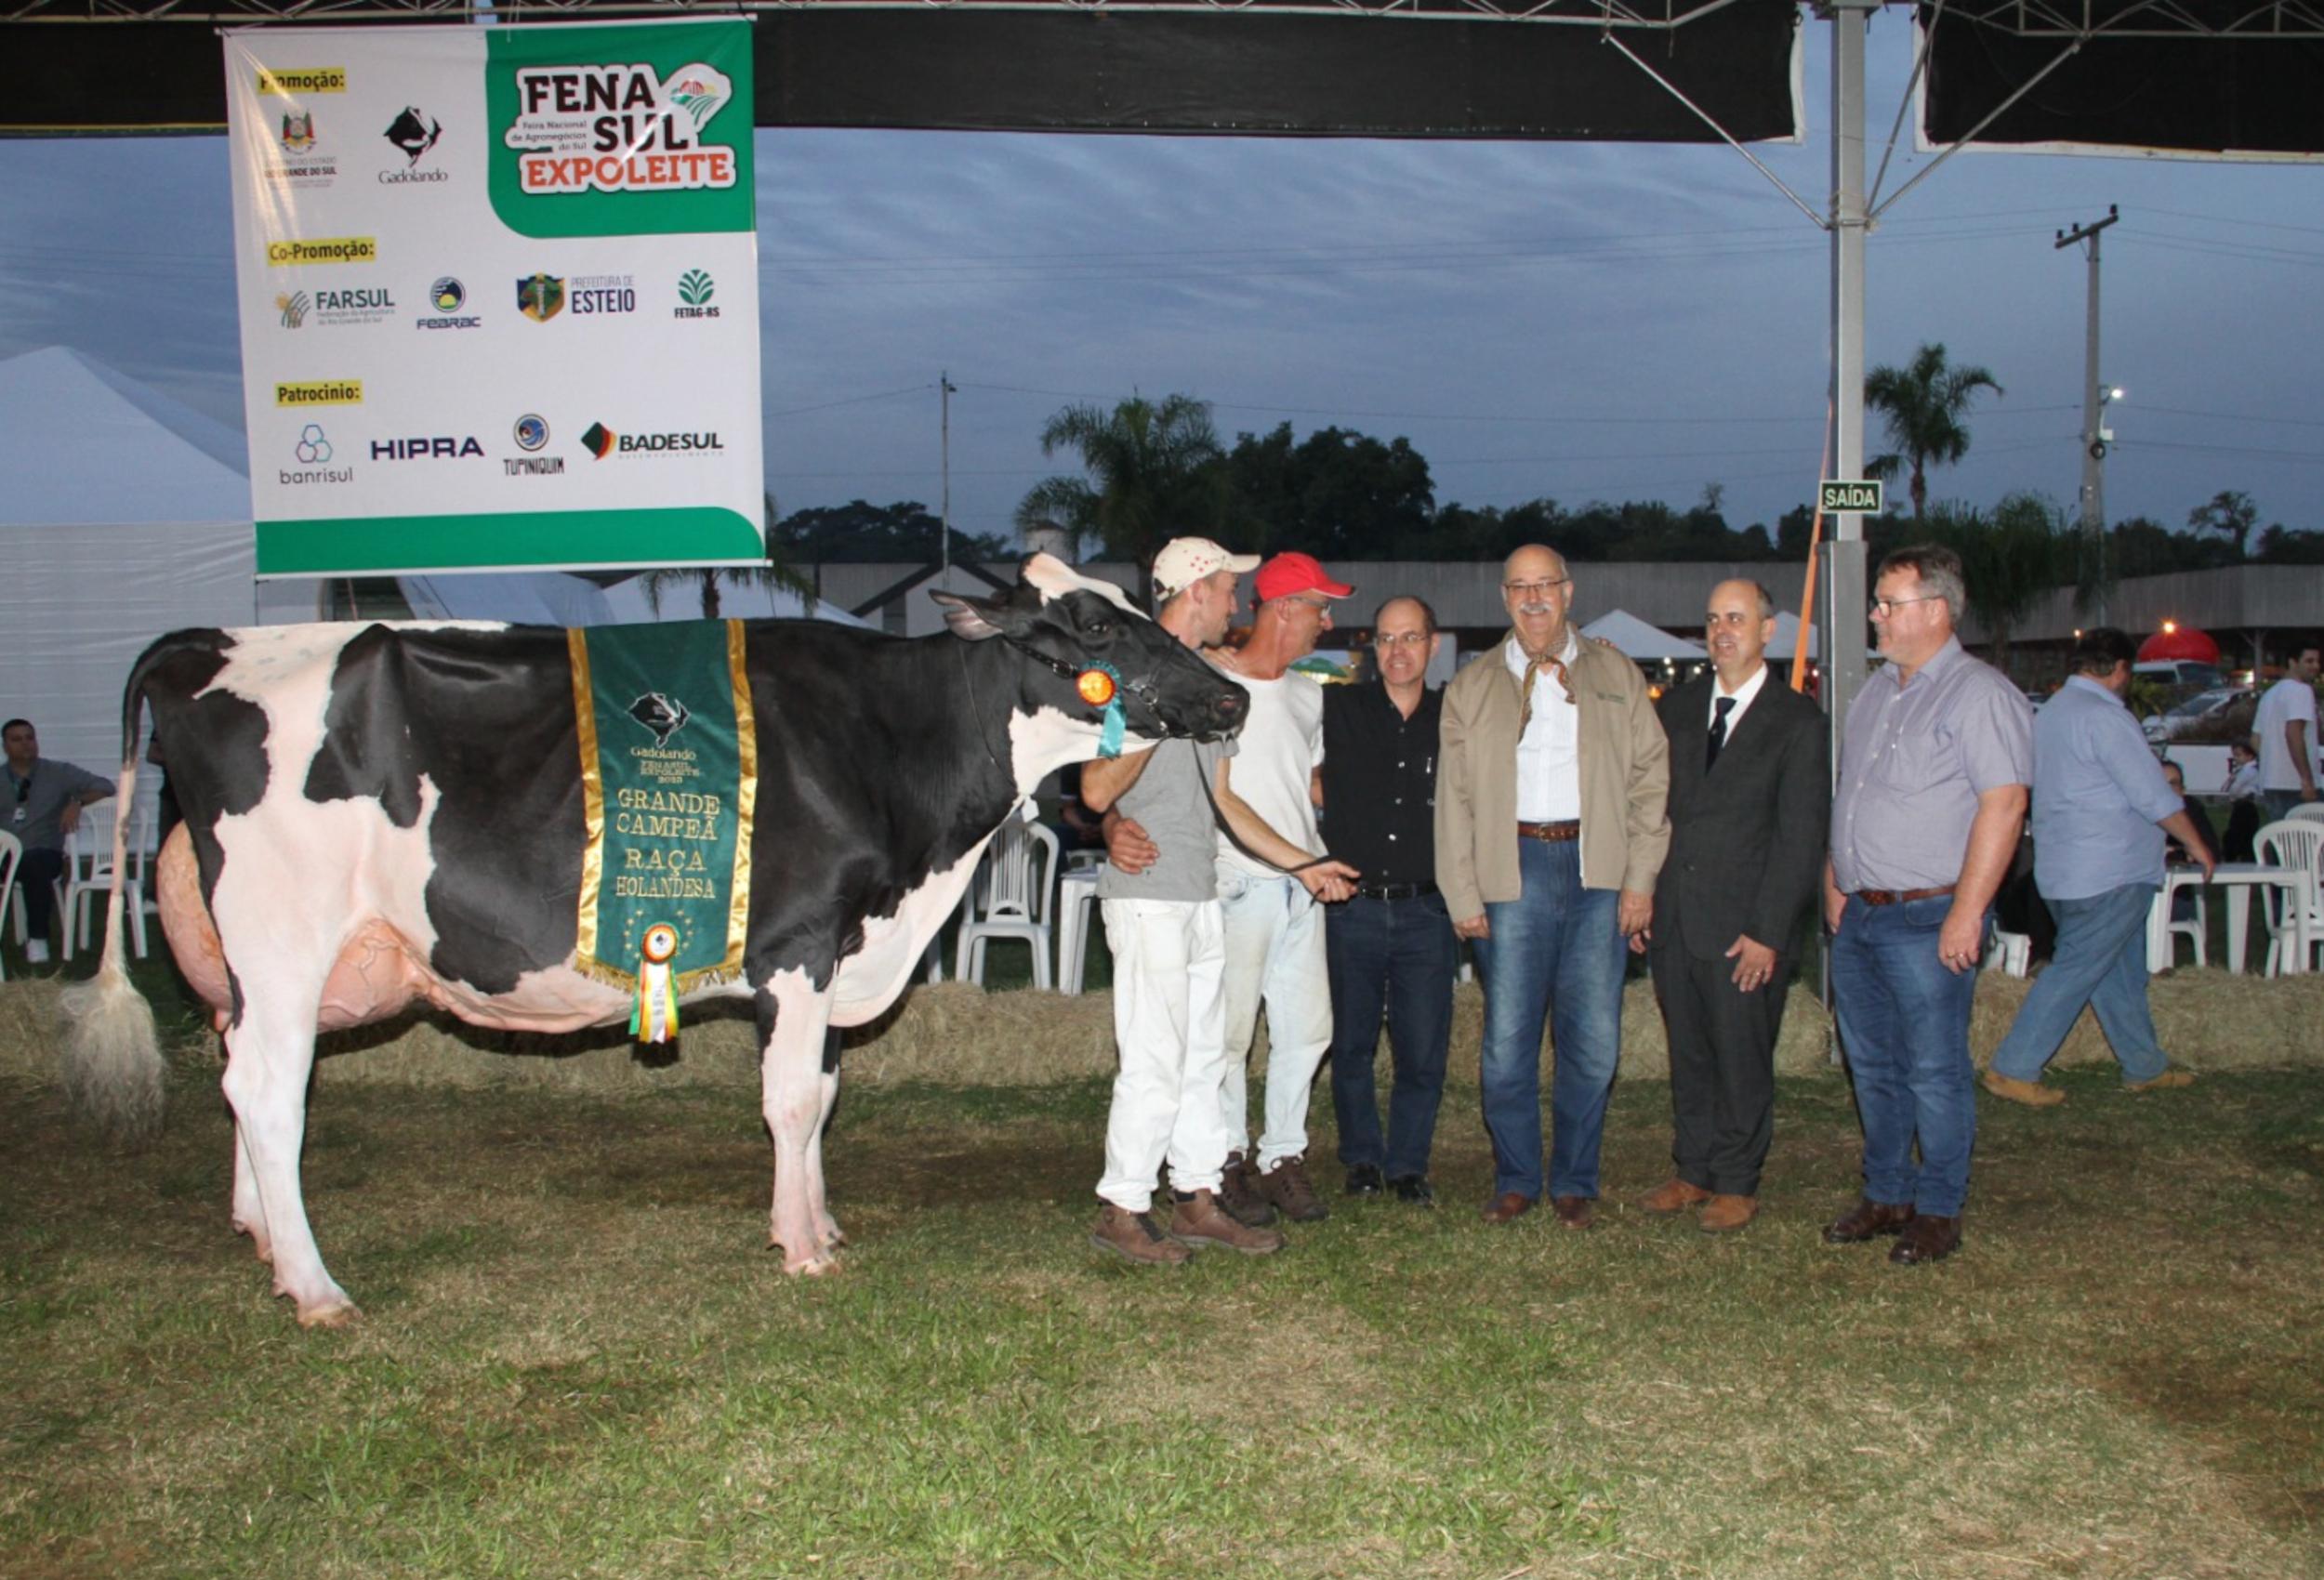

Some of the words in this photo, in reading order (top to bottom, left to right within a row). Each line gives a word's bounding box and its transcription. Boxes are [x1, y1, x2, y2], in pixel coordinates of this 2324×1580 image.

[524, 73, 655, 112] FENA
[593, 113, 690, 152] SUL
[378, 168, 449, 185] Gadolando
[526, 153, 730, 187] EXPOLEITE
[270, 240, 375, 262] Co-Promoção:
[316, 289, 395, 309] FARSUL
[572, 288, 635, 314] ESTEIO
[674, 307, 720, 318] FETAG-RS
[371, 437, 483, 460] HIPRA
[619, 432, 723, 452] BADESUL
[279, 467, 353, 484] banrisul
[503, 457, 564, 476] TUPINIQUIM
[1825, 483, 1876, 507] SAÍDA
[617, 788, 720, 815] GRANDE
[616, 812, 718, 841] CAMPEÃ
[625, 848, 707, 877] RAÇA
[615, 876, 716, 898] HOLANDESA
